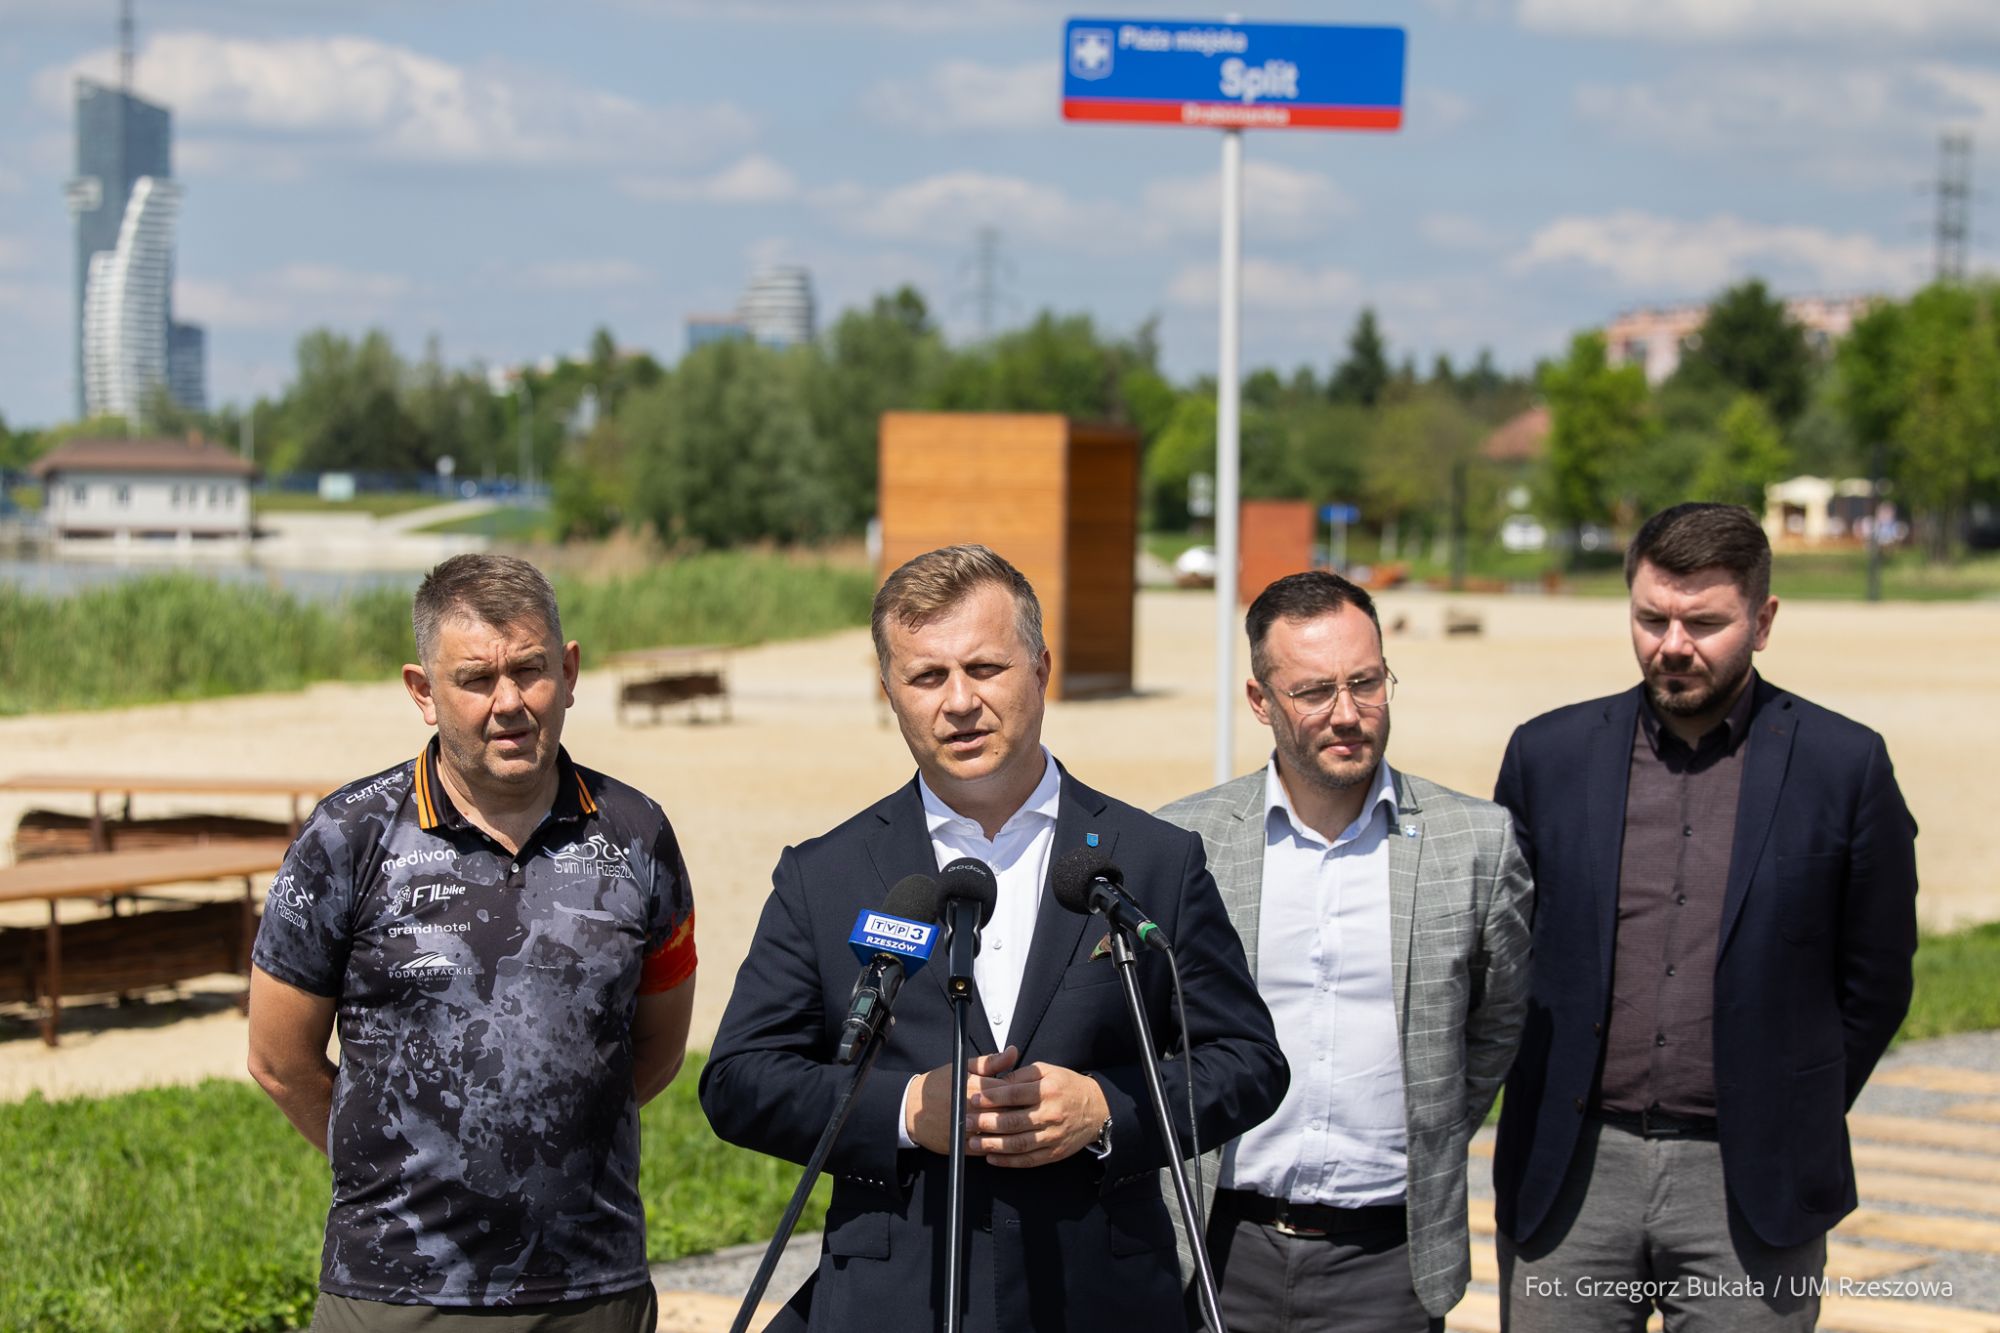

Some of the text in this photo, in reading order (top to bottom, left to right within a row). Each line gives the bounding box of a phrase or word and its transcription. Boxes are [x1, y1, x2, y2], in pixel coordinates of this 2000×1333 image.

[1219, 57, 1299, 105] Split
[381, 849, 457, 872] medivon
[554, 858, 579, 874] Swim
[388, 923, 432, 938] grand
[434, 922, 471, 933] hotel
[866, 935, 917, 953] RZESZÓW
[388, 967, 473, 979] PODKARPACKIE
